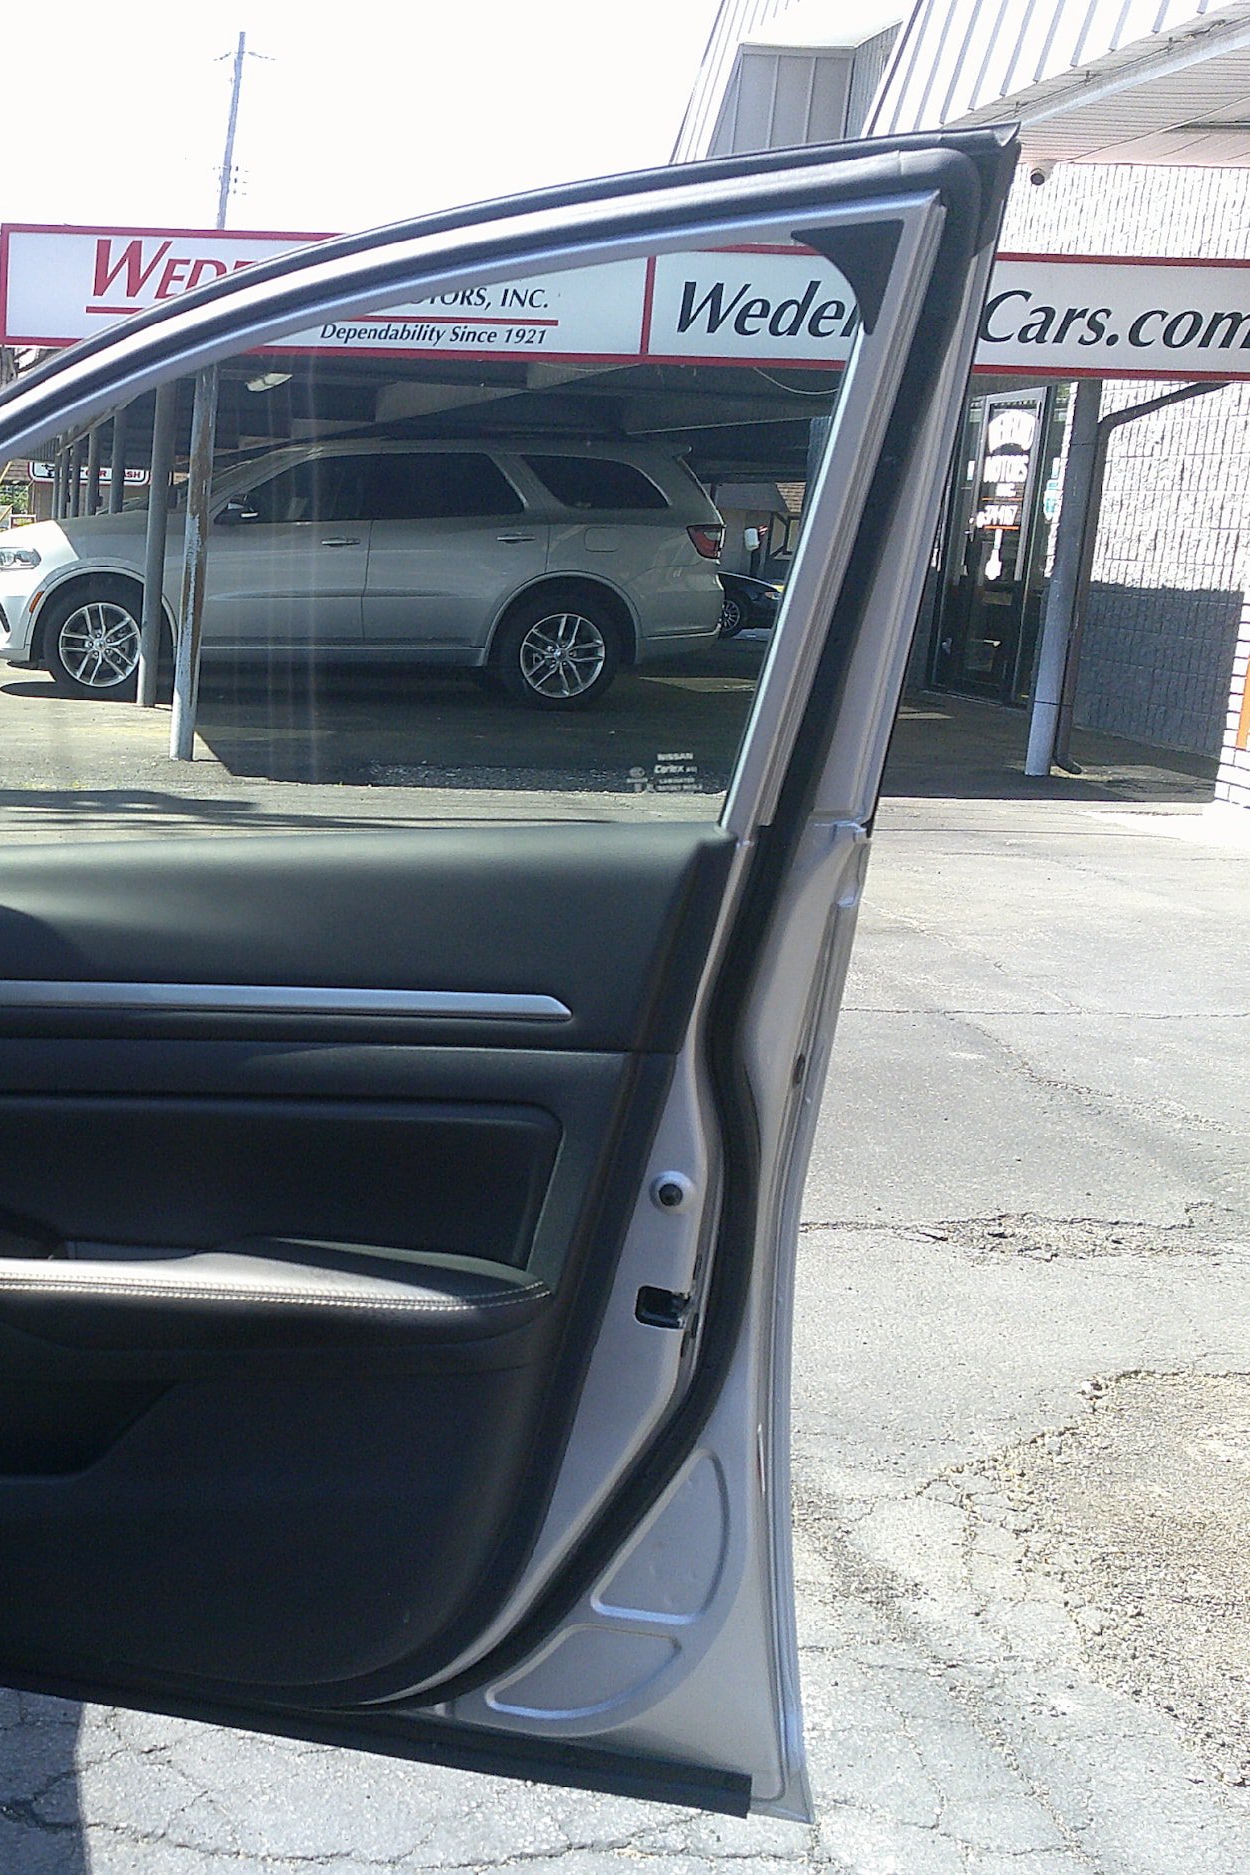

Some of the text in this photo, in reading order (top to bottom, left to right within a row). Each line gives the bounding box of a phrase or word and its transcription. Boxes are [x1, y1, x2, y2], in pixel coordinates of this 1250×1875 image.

[93, 239, 257, 299] WED
[500, 288, 549, 308] INC.
[320, 323, 547, 346] Dependability Since 1921
